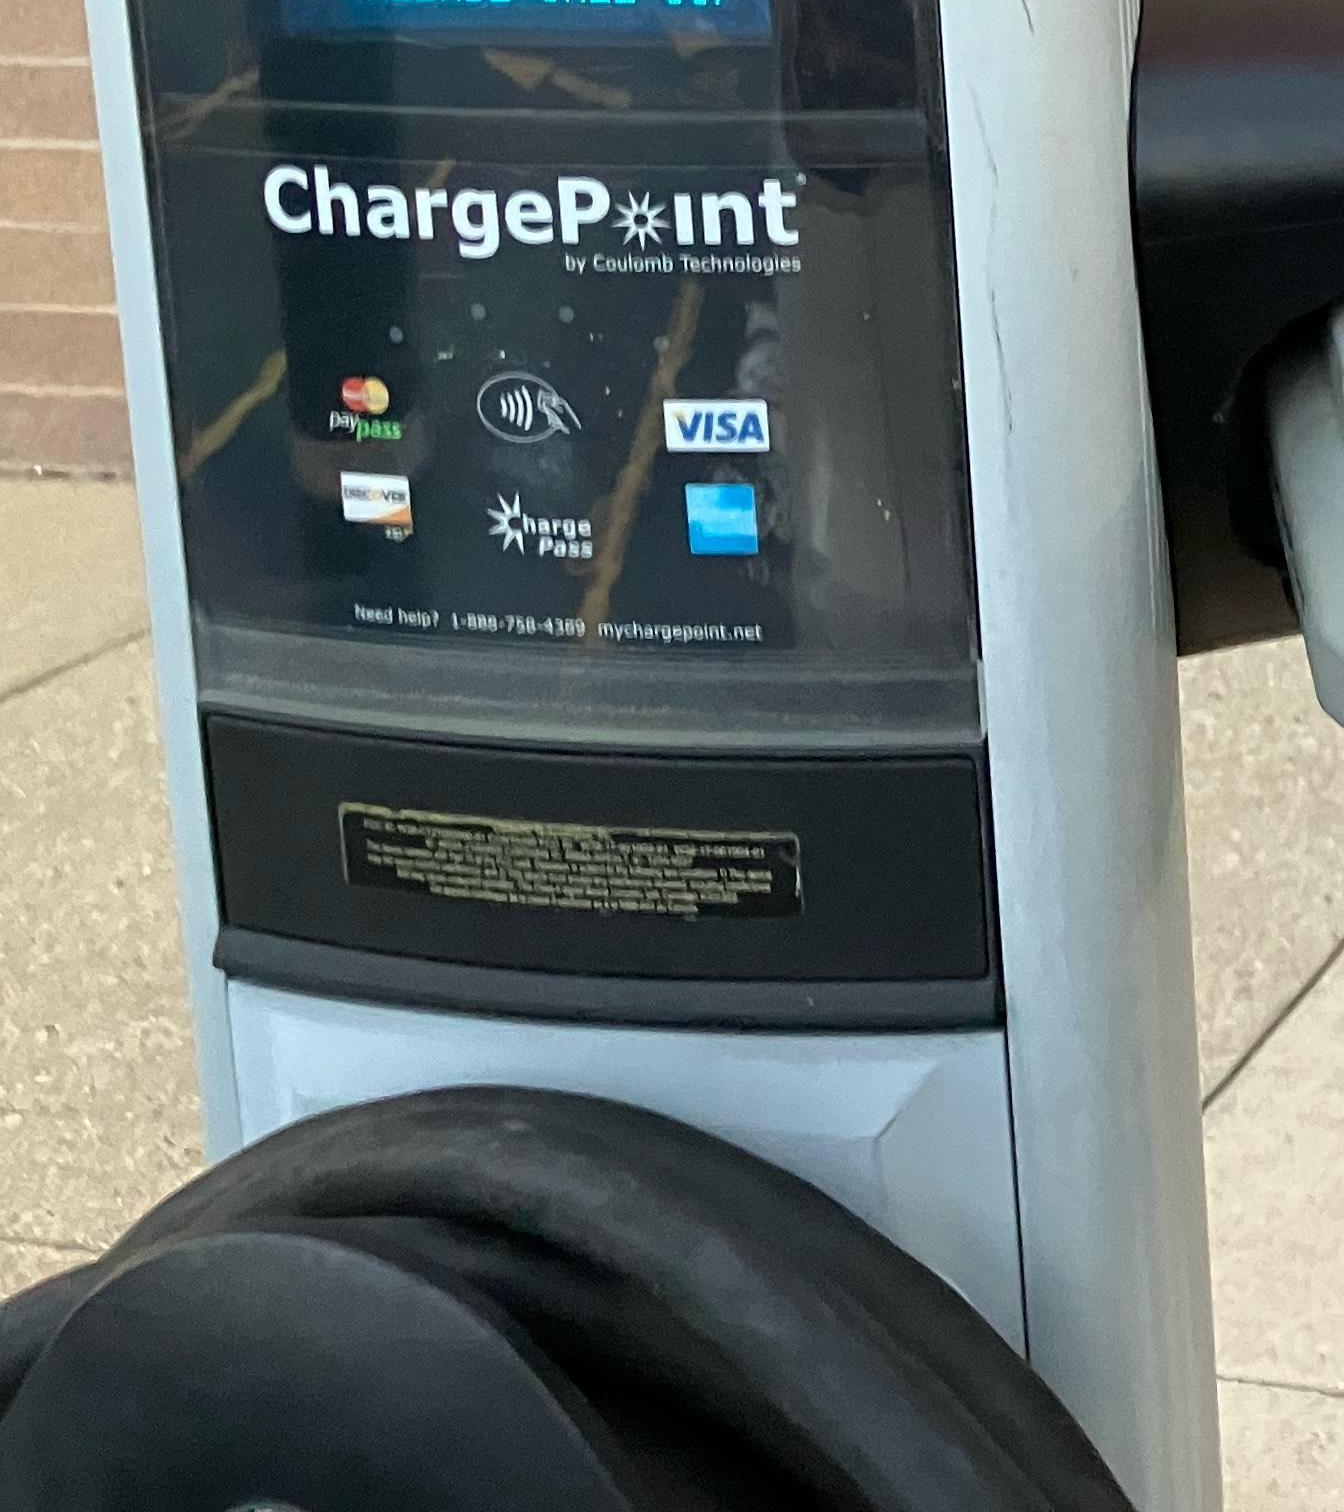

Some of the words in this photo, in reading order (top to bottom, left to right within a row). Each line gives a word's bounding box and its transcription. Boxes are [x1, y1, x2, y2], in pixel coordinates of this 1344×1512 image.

[564, 252, 586, 275] by
[593, 252, 674, 273] Coulomb
[678, 252, 802, 277] Technologies
[671, 409, 765, 444] VISA
[354, 603, 394, 625] Need
[397, 606, 440, 630] help?
[597, 621, 764, 645] mychargepoint.net
